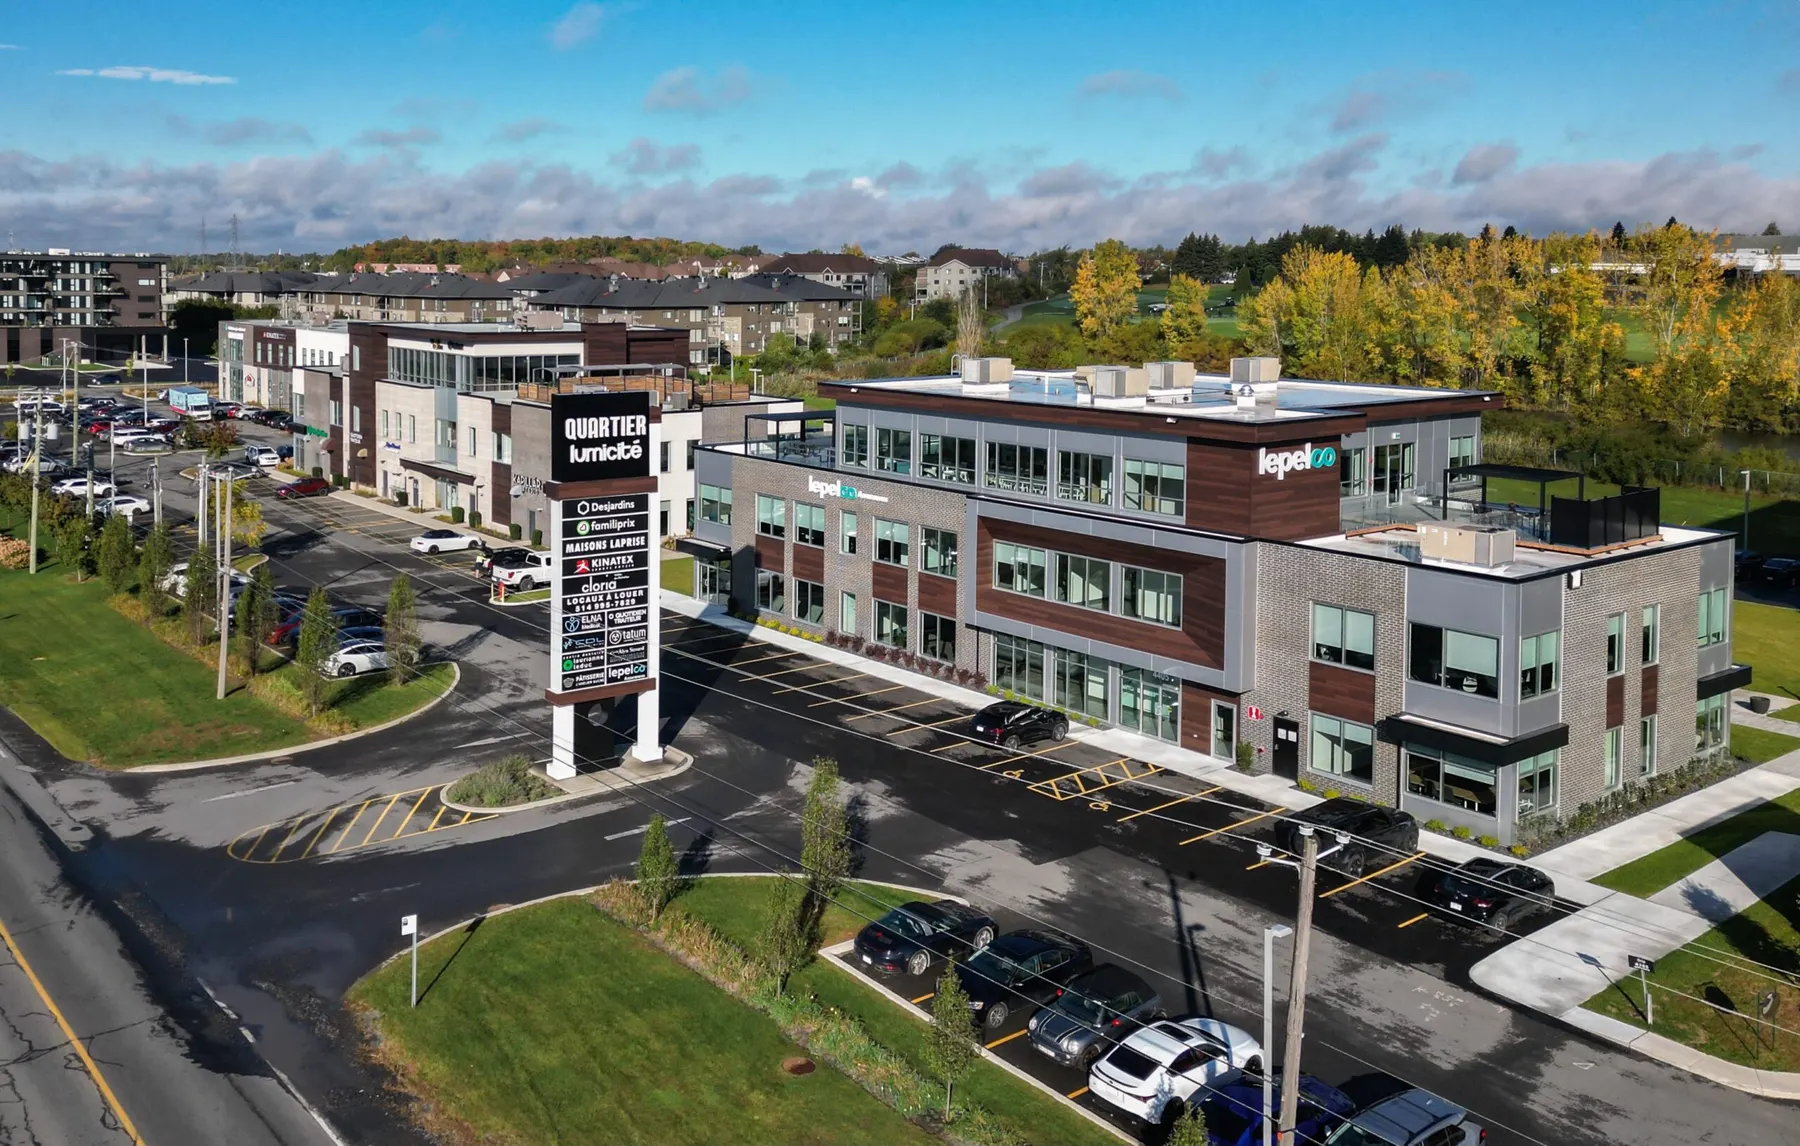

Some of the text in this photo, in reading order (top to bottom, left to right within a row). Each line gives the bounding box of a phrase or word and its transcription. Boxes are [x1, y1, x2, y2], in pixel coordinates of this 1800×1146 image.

[564, 414, 647, 441] QUARTIER
[569, 439, 643, 463] lumicité
[1258, 442, 1336, 480] lepelco
[808, 475, 857, 500] lepelco
[591, 500, 635, 512] Desjardins
[591, 518, 635, 531] familiprix
[565, 536, 645, 553] MAISONS LAPRISE
[591, 555, 634, 568] KINATEX
[581, 574, 617, 592] cloria
[566, 594, 604, 606] LOCAUX
[614, 590, 644, 600] LOUER
[575, 603, 592, 612] 514
[615, 609, 647, 618] QUOTIDIEN
[581, 614, 602, 624] ELNA
[622, 629, 646, 640] tatum
[608, 664, 646, 679] lepelco
